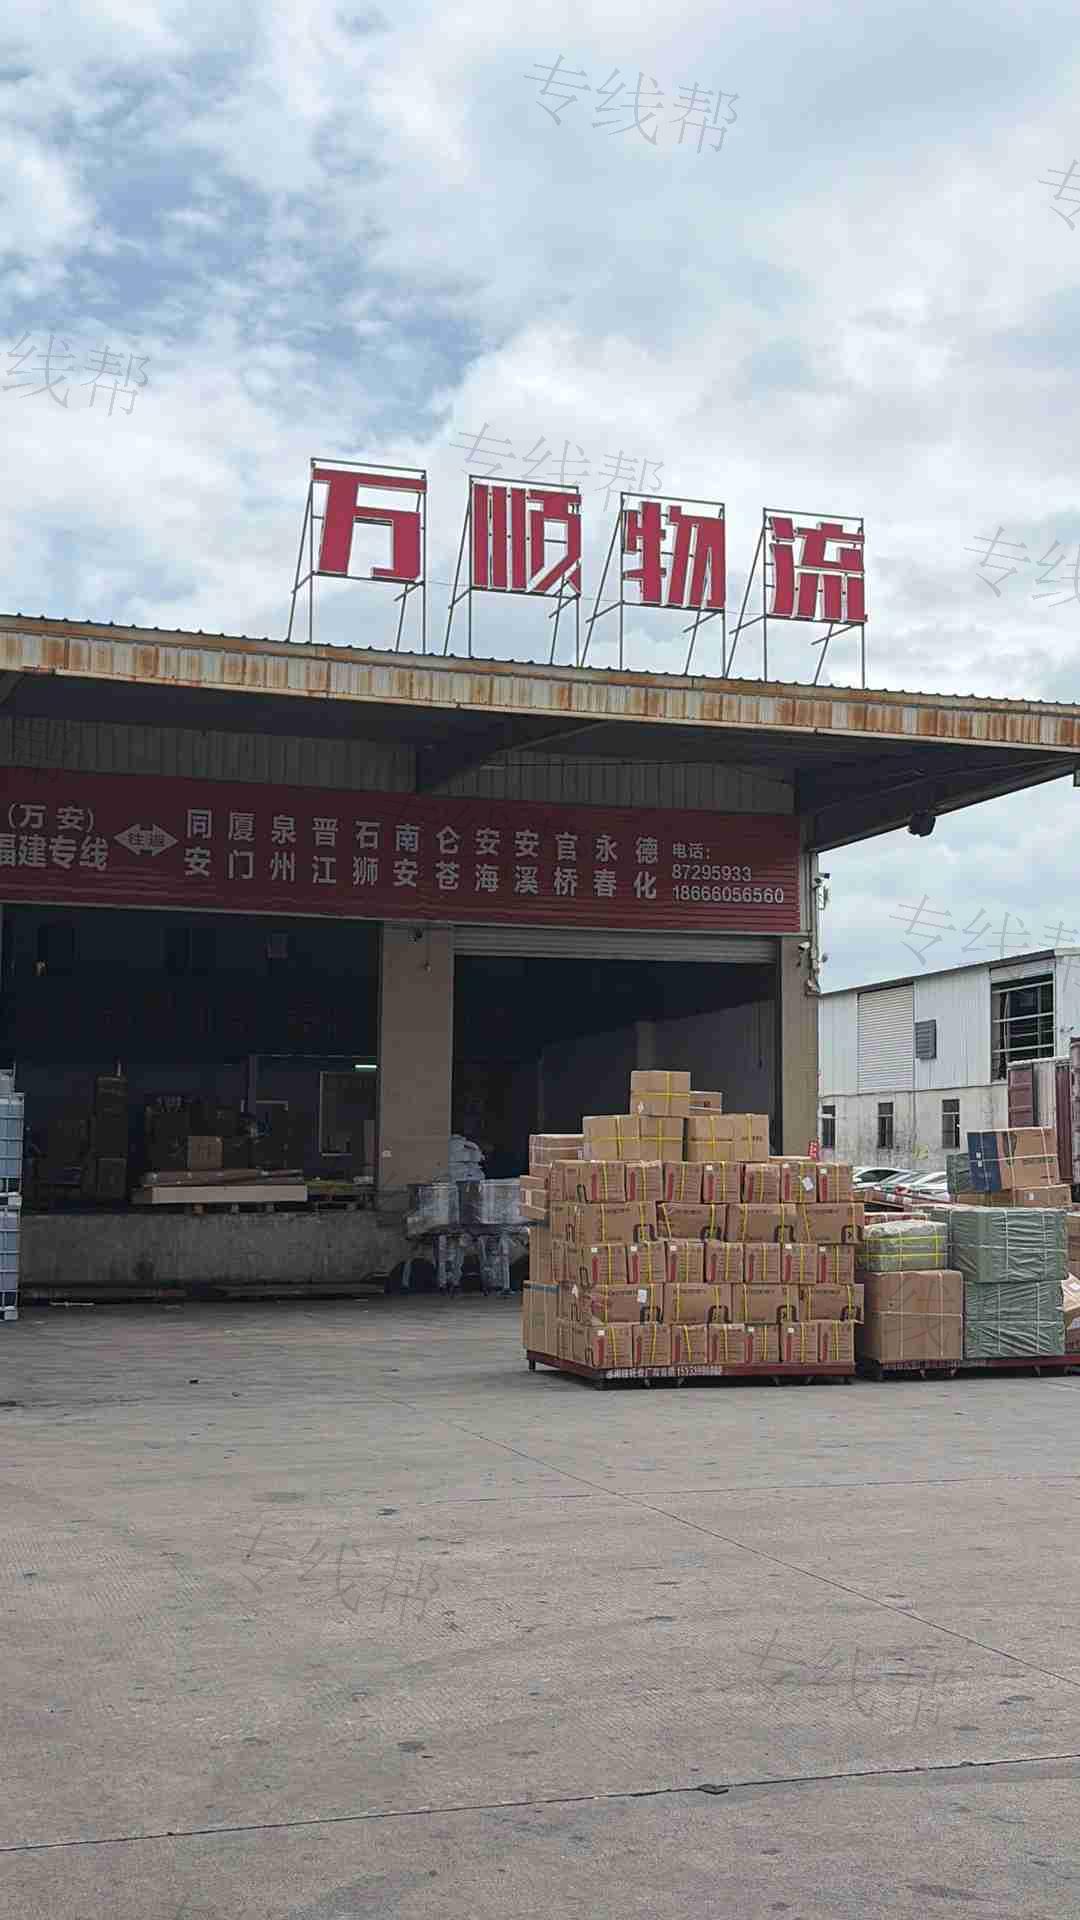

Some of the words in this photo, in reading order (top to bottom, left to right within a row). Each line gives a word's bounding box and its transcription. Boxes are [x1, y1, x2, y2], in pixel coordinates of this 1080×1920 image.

[311, 467, 868, 623] 万顺物流
[671, 864, 752, 882] 87295933
[671, 886, 784, 904] 18666056560
